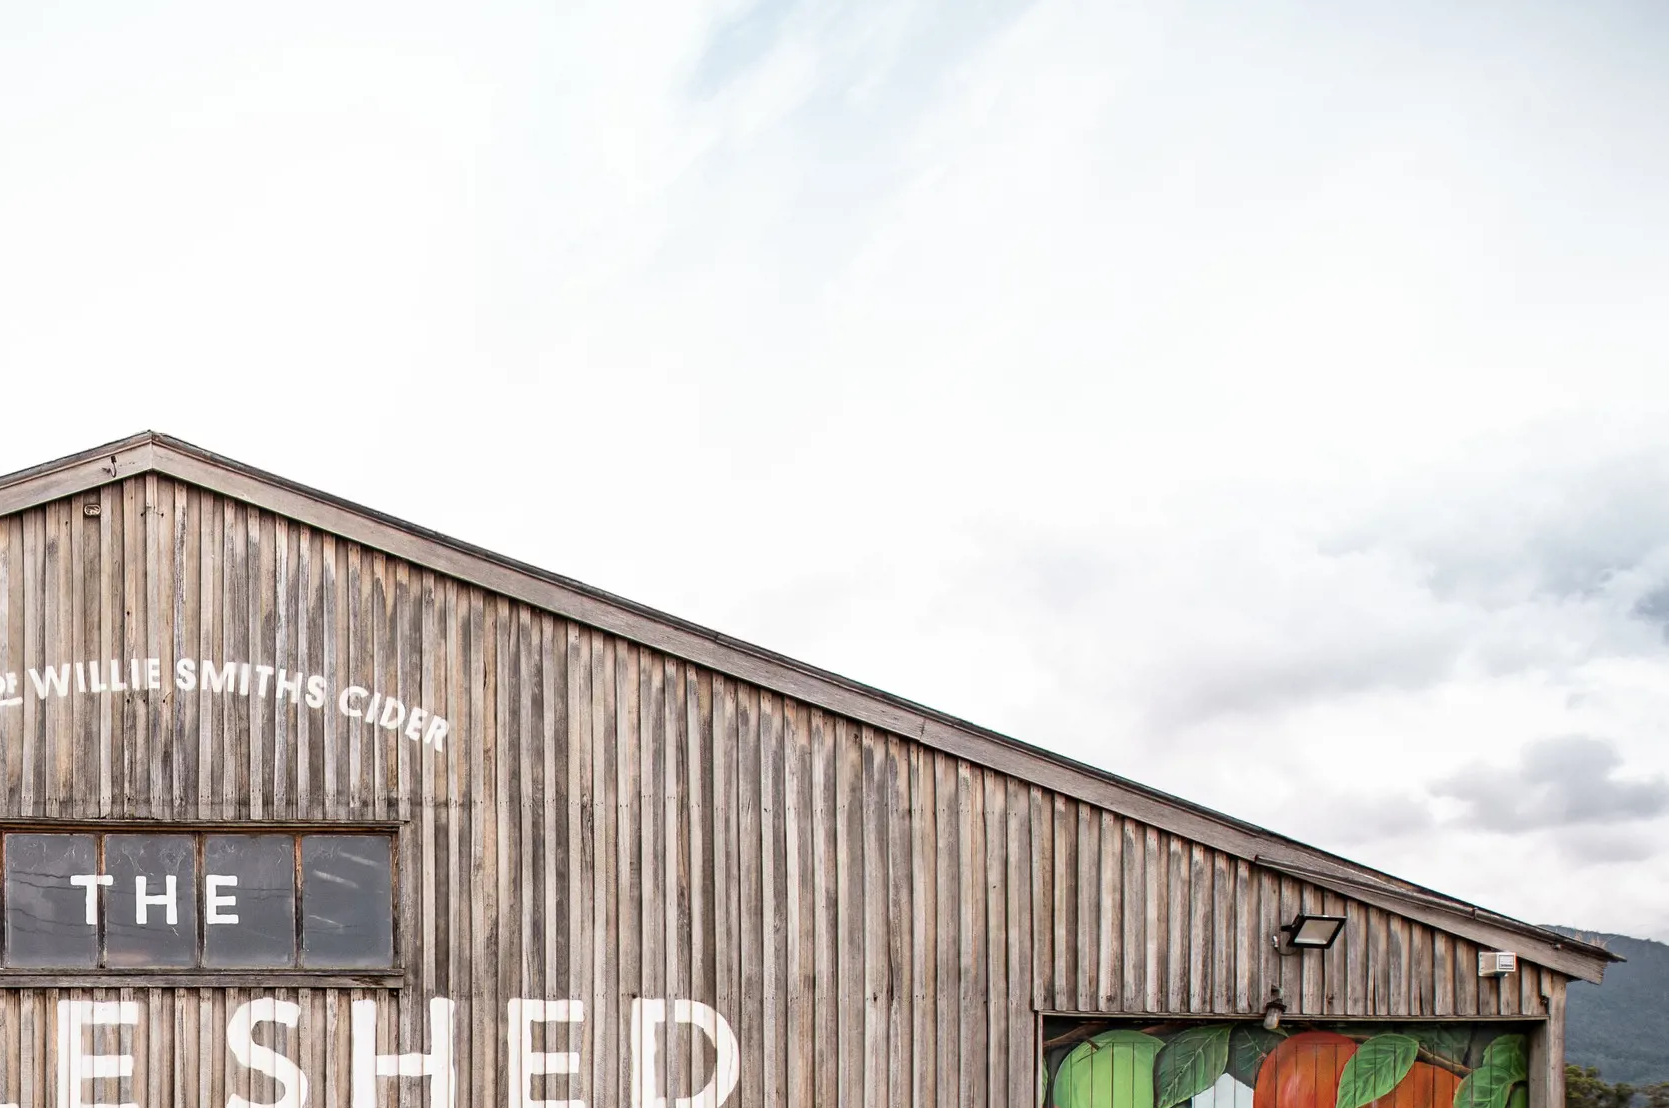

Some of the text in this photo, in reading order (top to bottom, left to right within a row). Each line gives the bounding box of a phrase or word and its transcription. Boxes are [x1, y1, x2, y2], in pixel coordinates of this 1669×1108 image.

[28, 658, 160, 700] WILLIE
[176, 658, 328, 708] SMITHS
[339, 686, 450, 752] CIDER
[70, 874, 239, 925] THE
